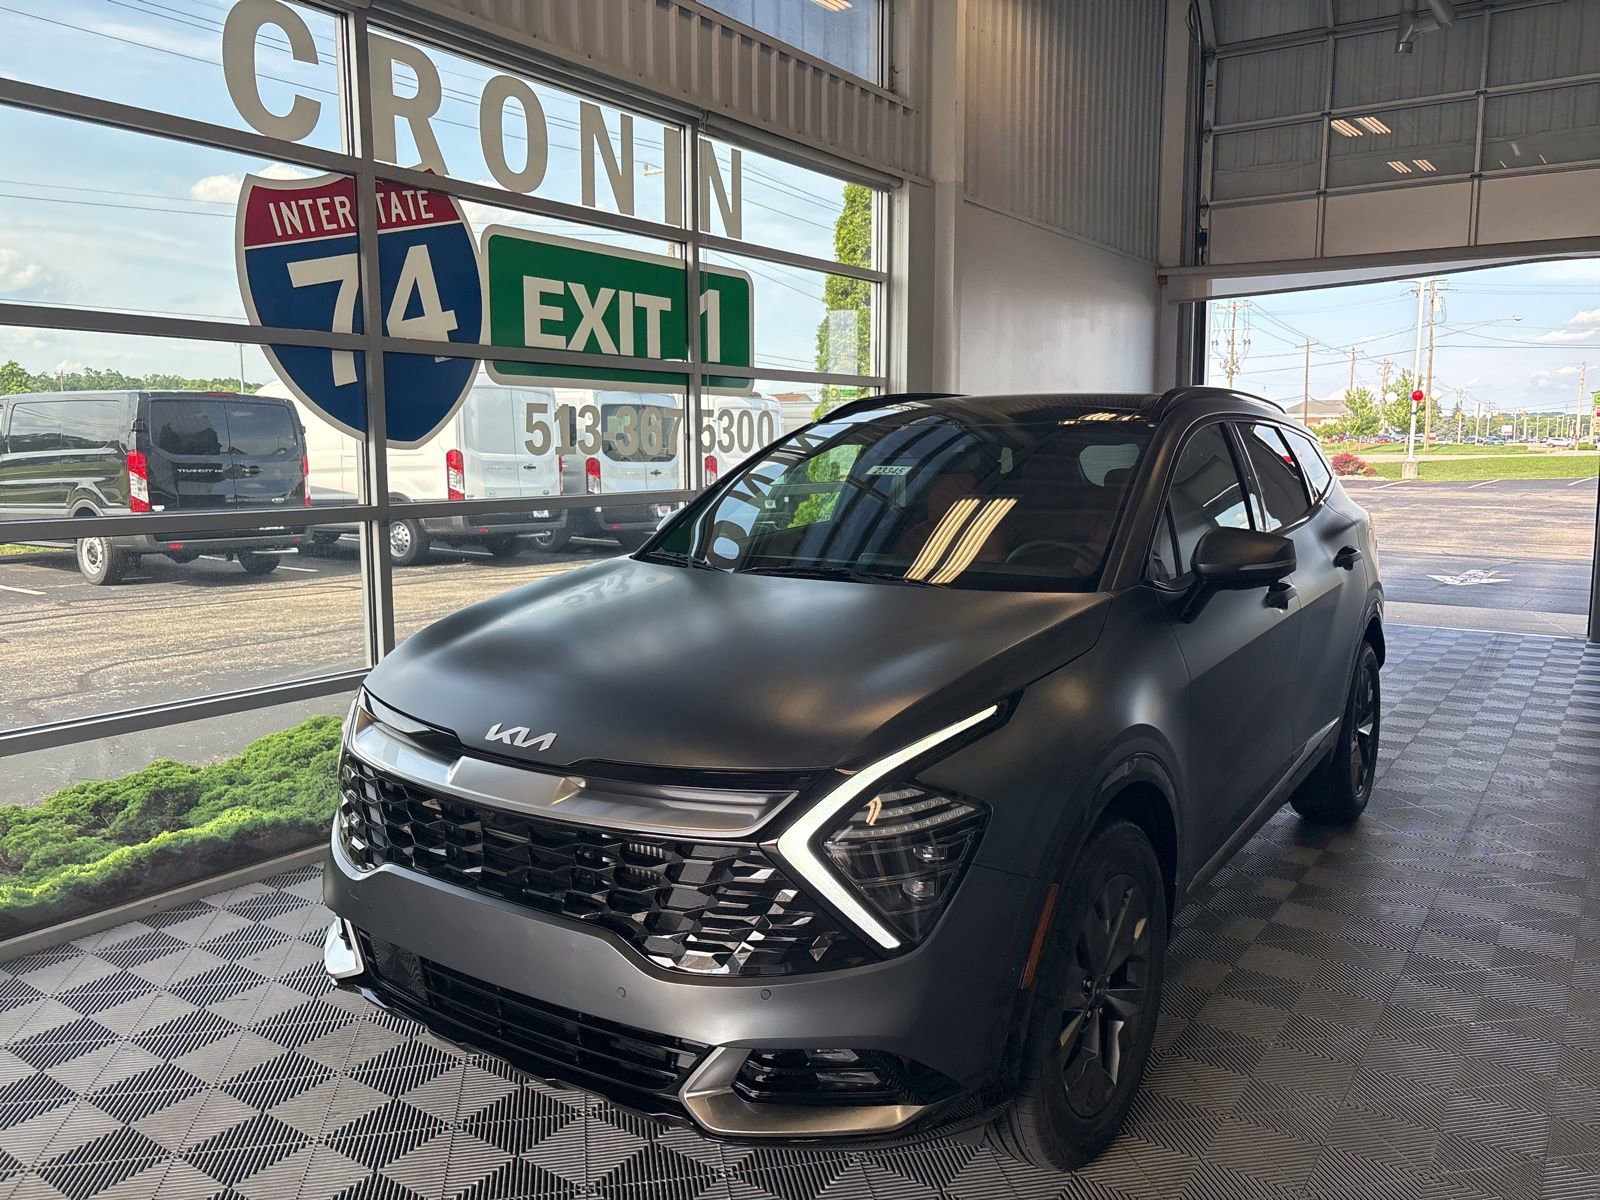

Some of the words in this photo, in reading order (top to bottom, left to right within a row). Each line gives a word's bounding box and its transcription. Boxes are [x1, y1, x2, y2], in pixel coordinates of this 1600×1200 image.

[222, 0, 743, 240] CRONIN
[268, 189, 435, 237] INTERTATE
[286, 243, 459, 388] 74
[522, 274, 673, 360] EXIT
[698, 288, 721, 363] 1
[524, 402, 774, 456] 513-3675300
[872, 466, 906, 475] 23345
[485, 722, 557, 752] KIA
